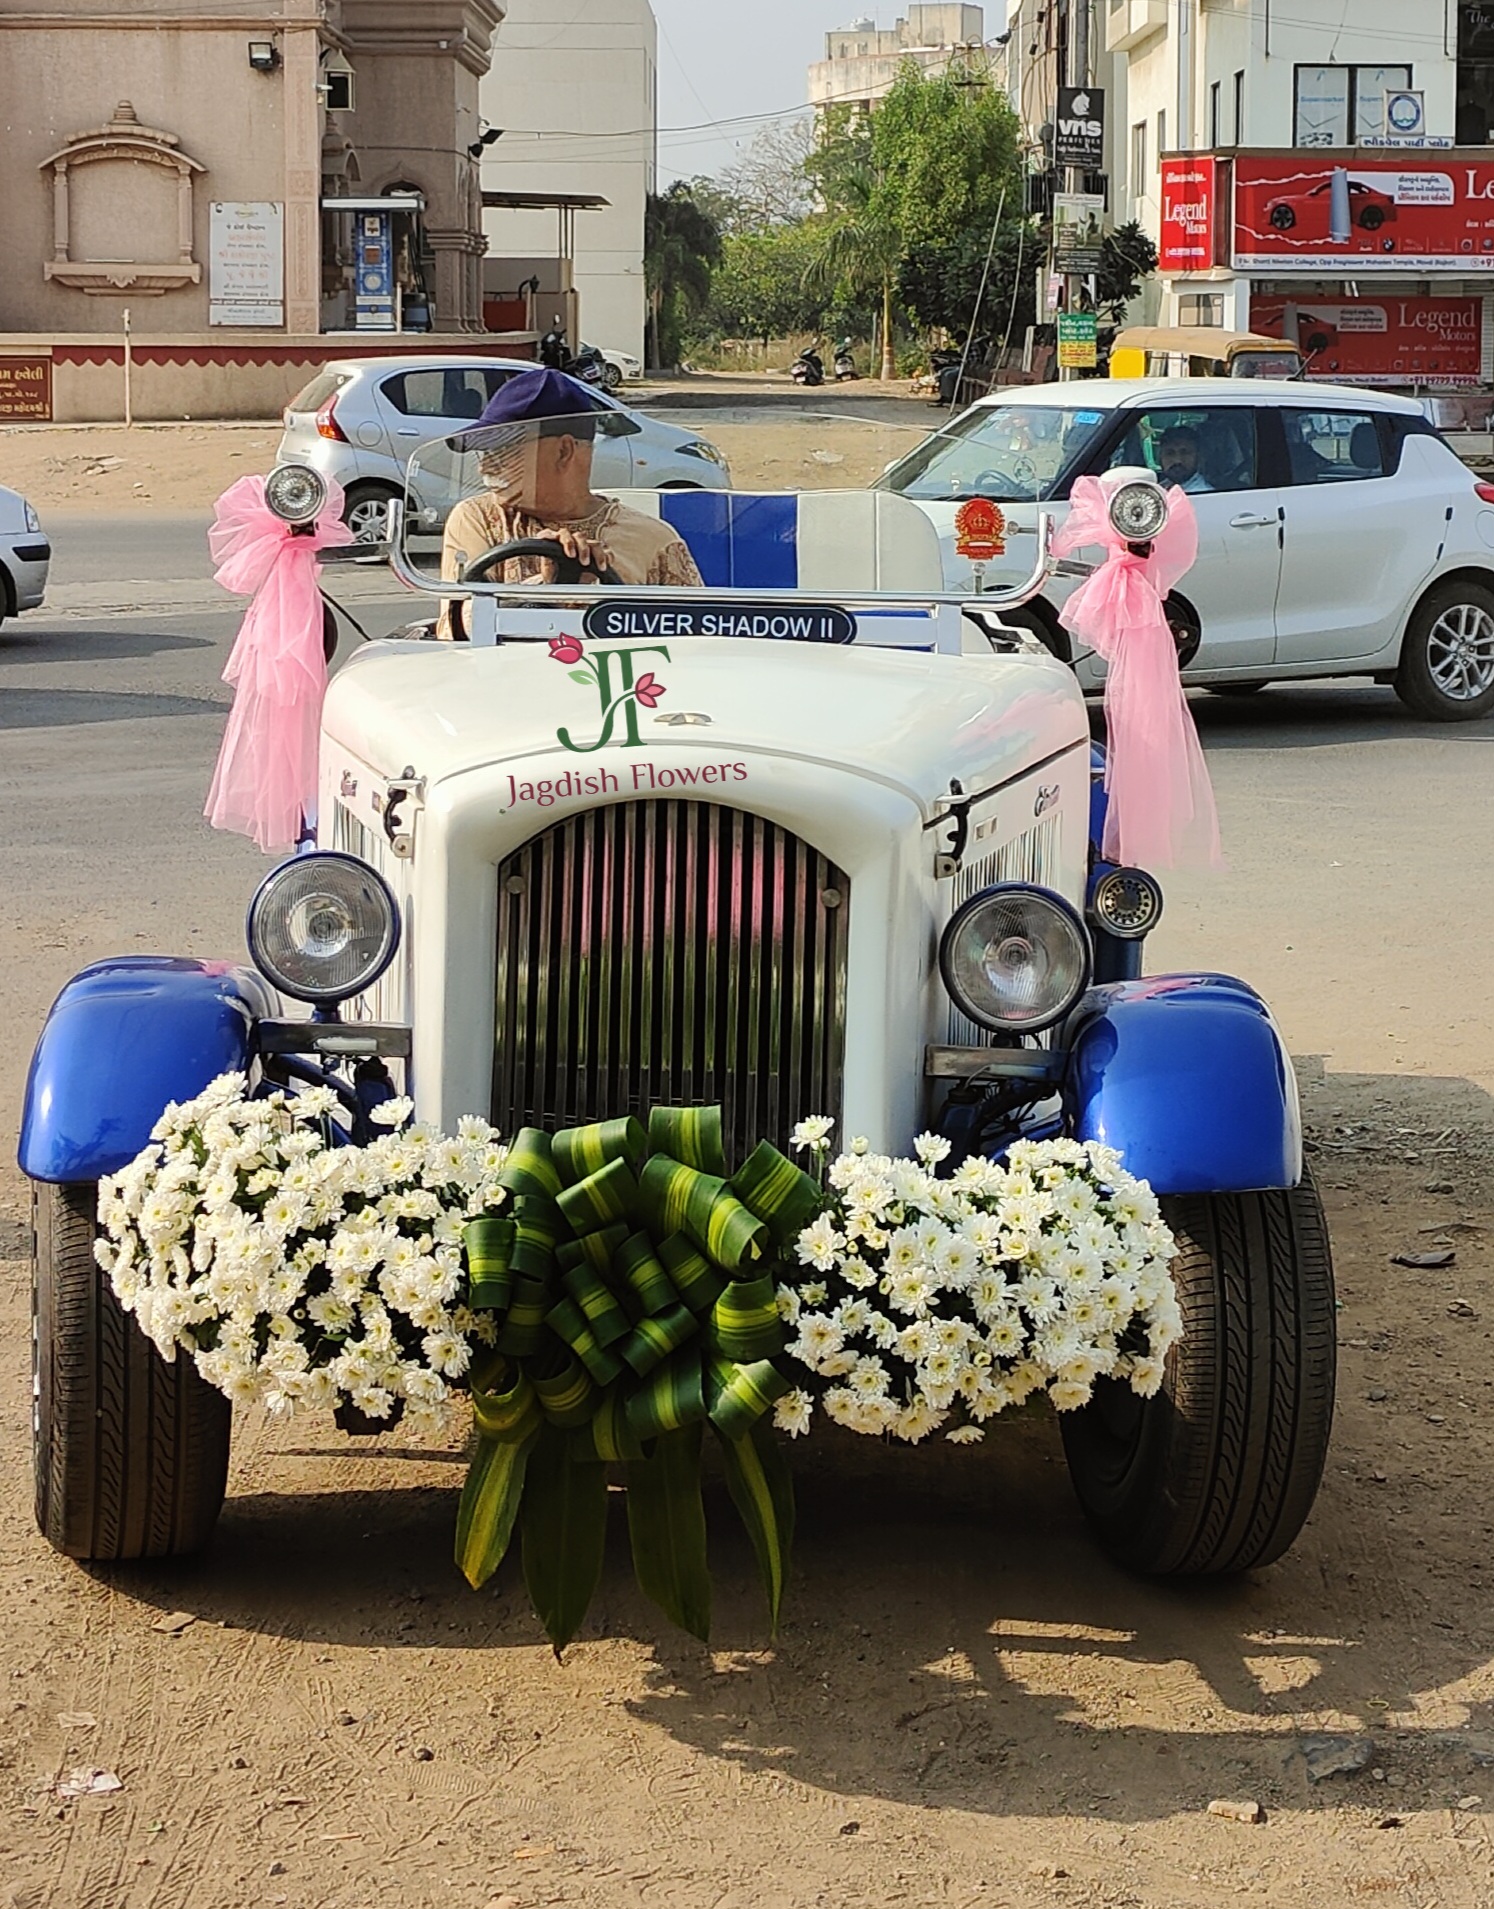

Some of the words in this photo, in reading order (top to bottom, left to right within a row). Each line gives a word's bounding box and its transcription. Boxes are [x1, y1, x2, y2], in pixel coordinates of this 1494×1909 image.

[1058, 119, 1102, 137] vns
[1164, 193, 1207, 227] Legend
[1398, 302, 1476, 332] Legend
[1439, 328, 1476, 341] Motors
[606, 612, 694, 636] SILVER
[701, 614, 813, 638] SHADOW
